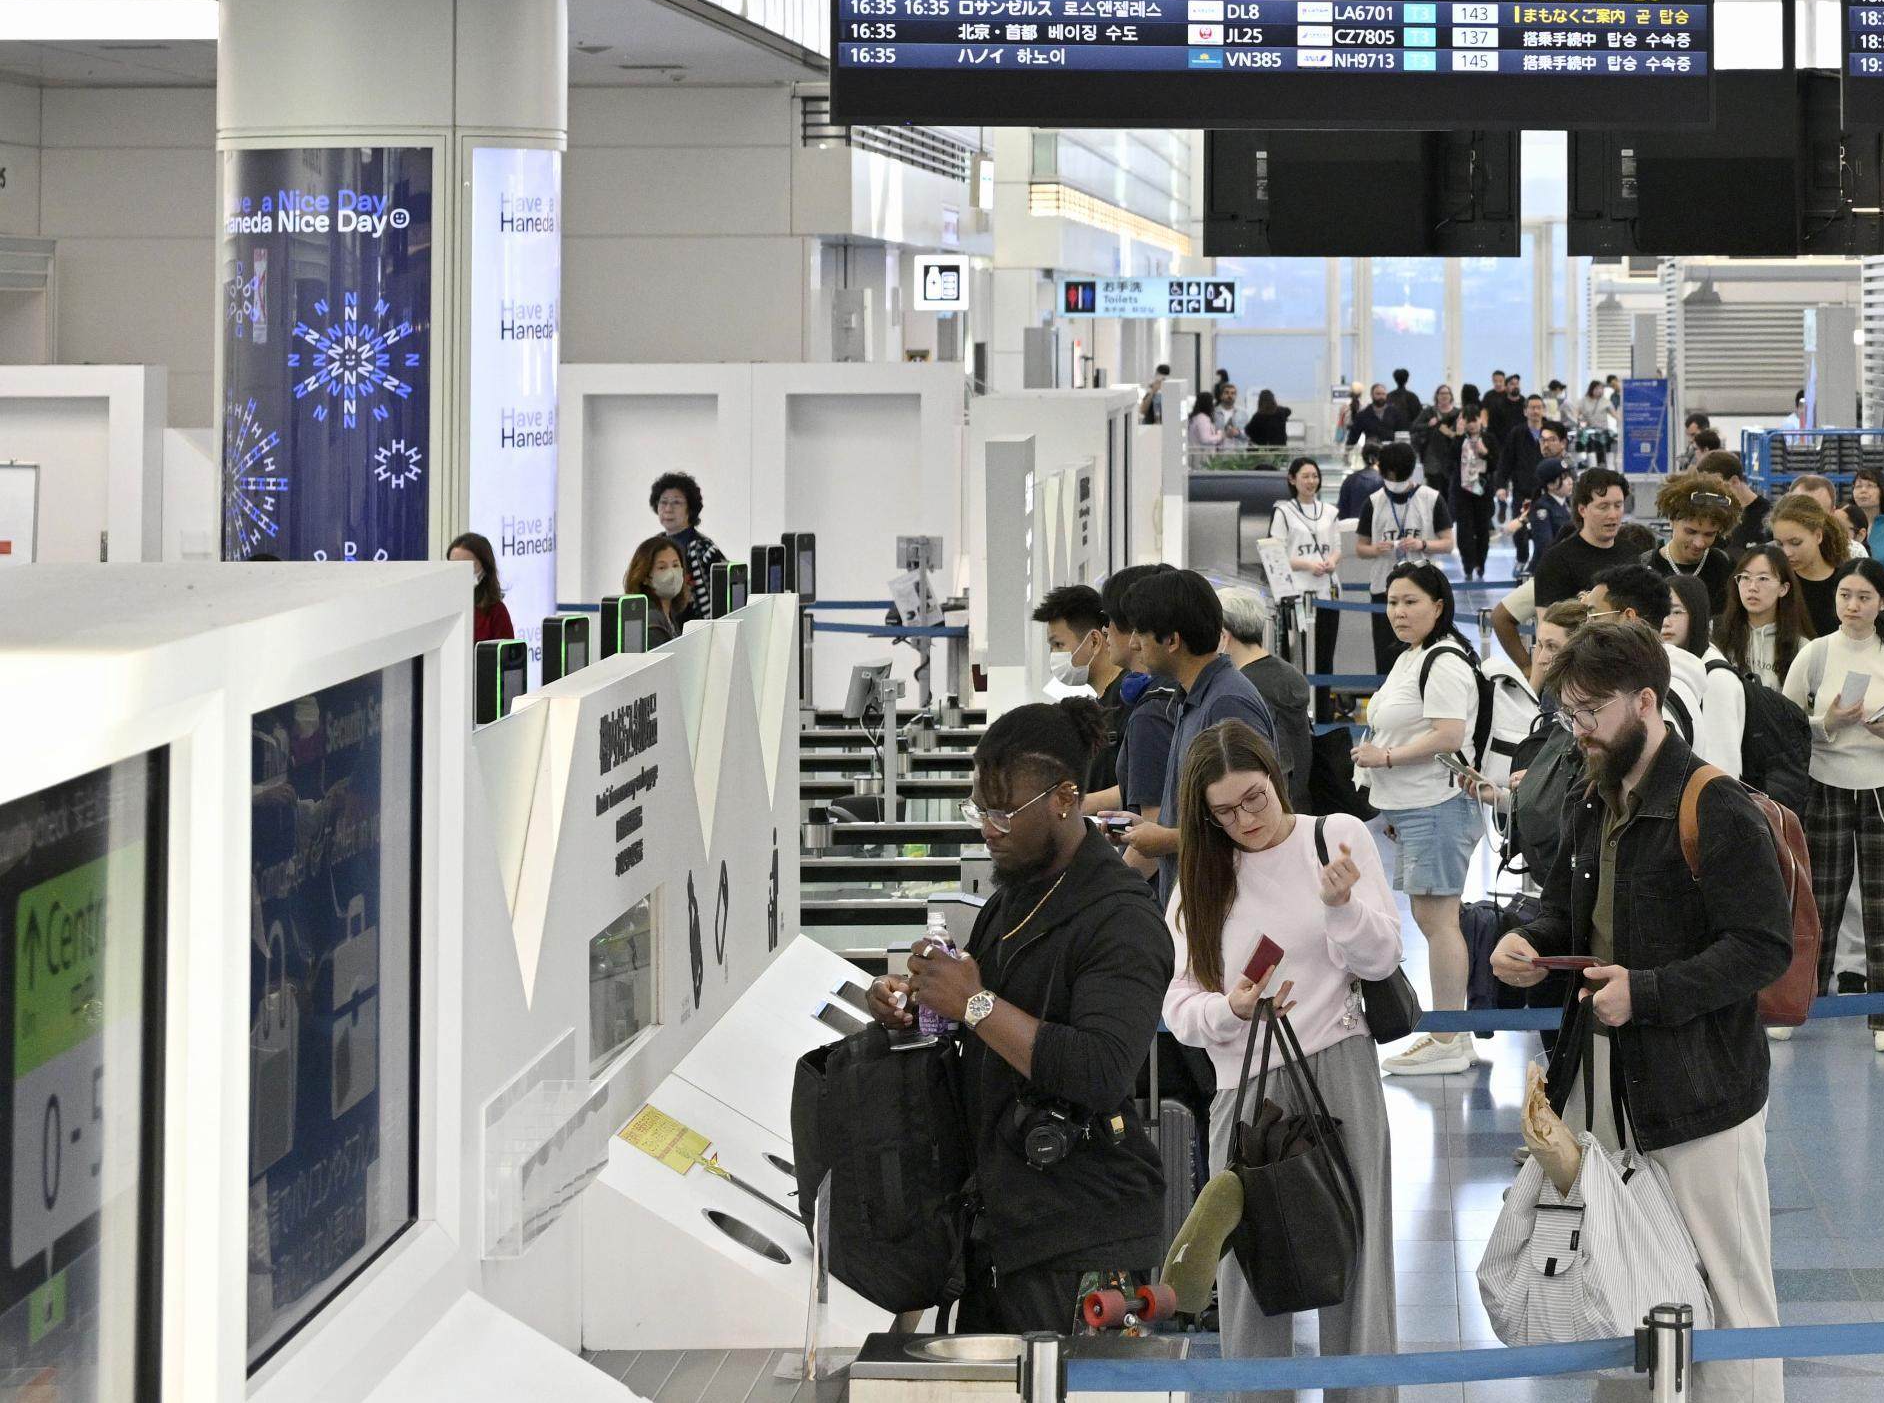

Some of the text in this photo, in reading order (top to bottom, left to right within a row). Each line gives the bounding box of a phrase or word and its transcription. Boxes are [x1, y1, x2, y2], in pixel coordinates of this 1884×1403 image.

[1334, 5, 1393, 21] LA6701
[1523, 4, 1626, 24] まもなくご案内
[1226, 27, 1263, 44] JL25
[850, 47, 1282, 68] 16:35 ハノイ 하노이 VN385
[278, 190, 329, 213] Nice
[337, 190, 388, 217] Day
[500, 193, 542, 213] Have
[278, 211, 330, 232] Nice
[337, 210, 388, 238] Day
[500, 213, 554, 234] Haneda
[1103, 282, 1142, 293] お手洗
[1104, 295, 1138, 304] Toilets
[500, 300, 542, 320] Have
[500, 320, 554, 341] Haneda
[500, 407, 542, 427] Have
[500, 427, 554, 448] Haneda
[500, 515, 542, 535] Have
[500, 535, 554, 556] Haneda
[1298, 544, 1331, 557] STAF
